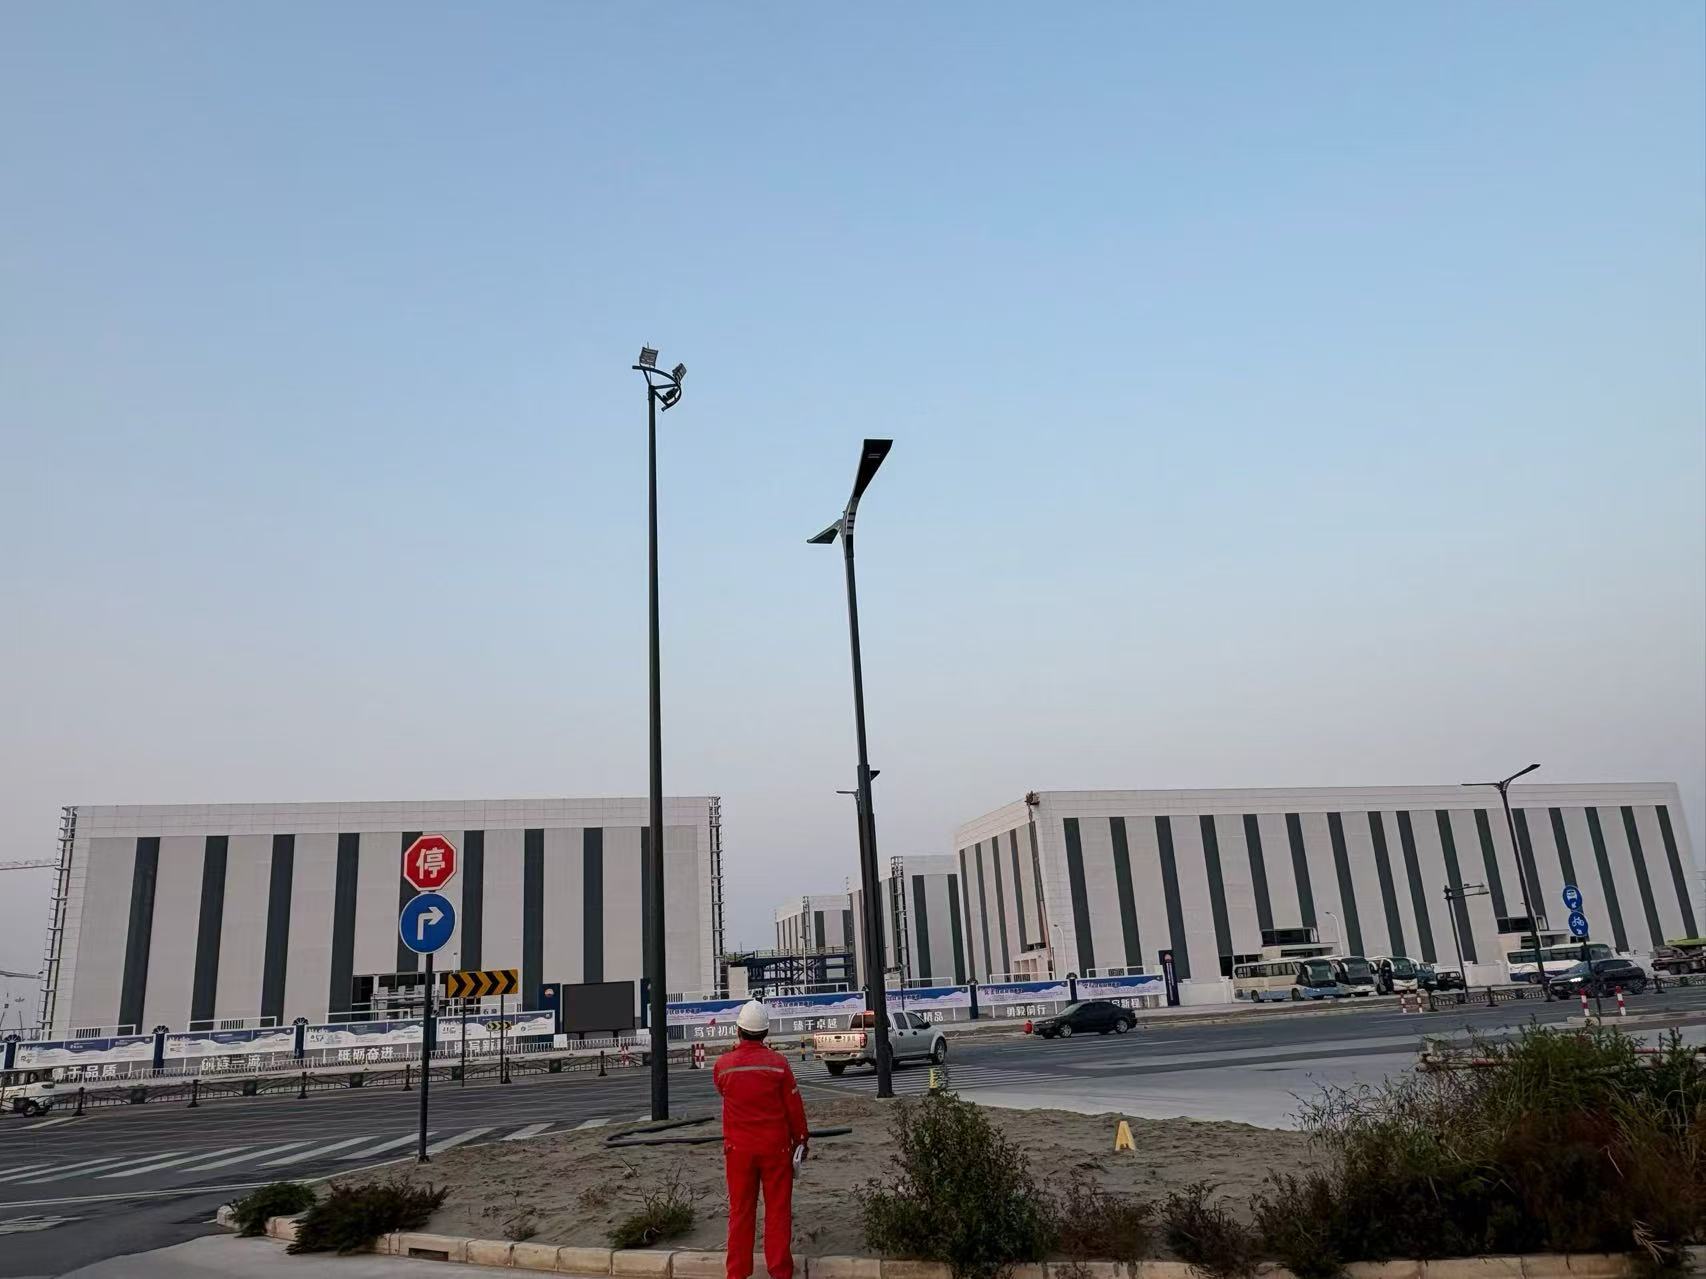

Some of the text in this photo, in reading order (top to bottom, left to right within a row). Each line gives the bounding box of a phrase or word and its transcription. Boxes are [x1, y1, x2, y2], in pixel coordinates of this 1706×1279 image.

[416, 847, 446, 880] 停
[694, 1025, 737, 1037] 笃守初心
[338, 1046, 394, 1061] 砥砺奋进
